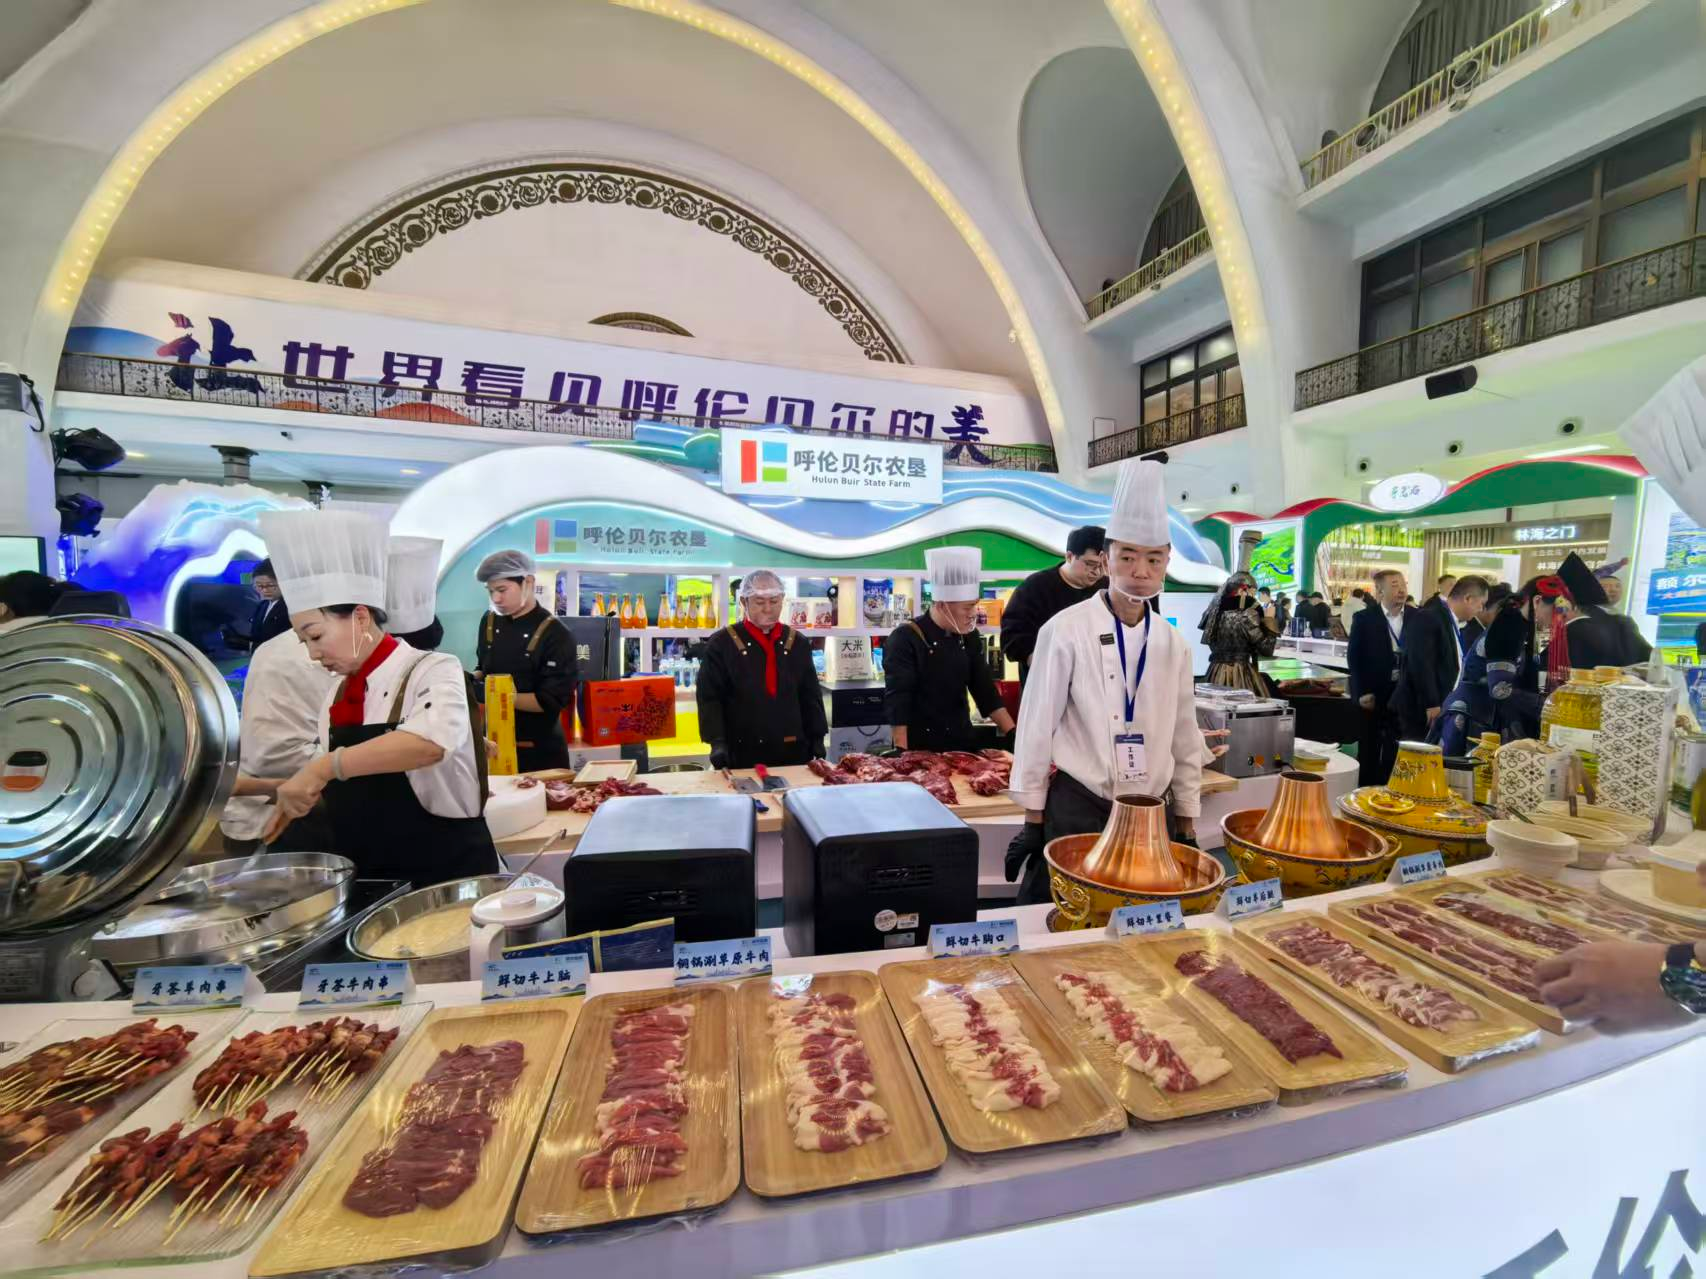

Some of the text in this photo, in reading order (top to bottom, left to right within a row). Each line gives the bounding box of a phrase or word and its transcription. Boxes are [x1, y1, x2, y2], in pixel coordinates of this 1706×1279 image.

[156, 312, 993, 464] 让世界看见呼伦贝尔的美
[794, 450, 927, 478] 呼伦贝尔农垦
[812, 475, 911, 488] Hulun Buir State Farm
[583, 527, 707, 547] 呼伦贝尔农垦
[840, 639, 864, 652] 大米
[677, 950, 770, 970] 铜锅涮草原牛肉
[317, 975, 390, 993] 牙签牛肉串
[497, 969, 571, 988] 鲜切牛上脑
